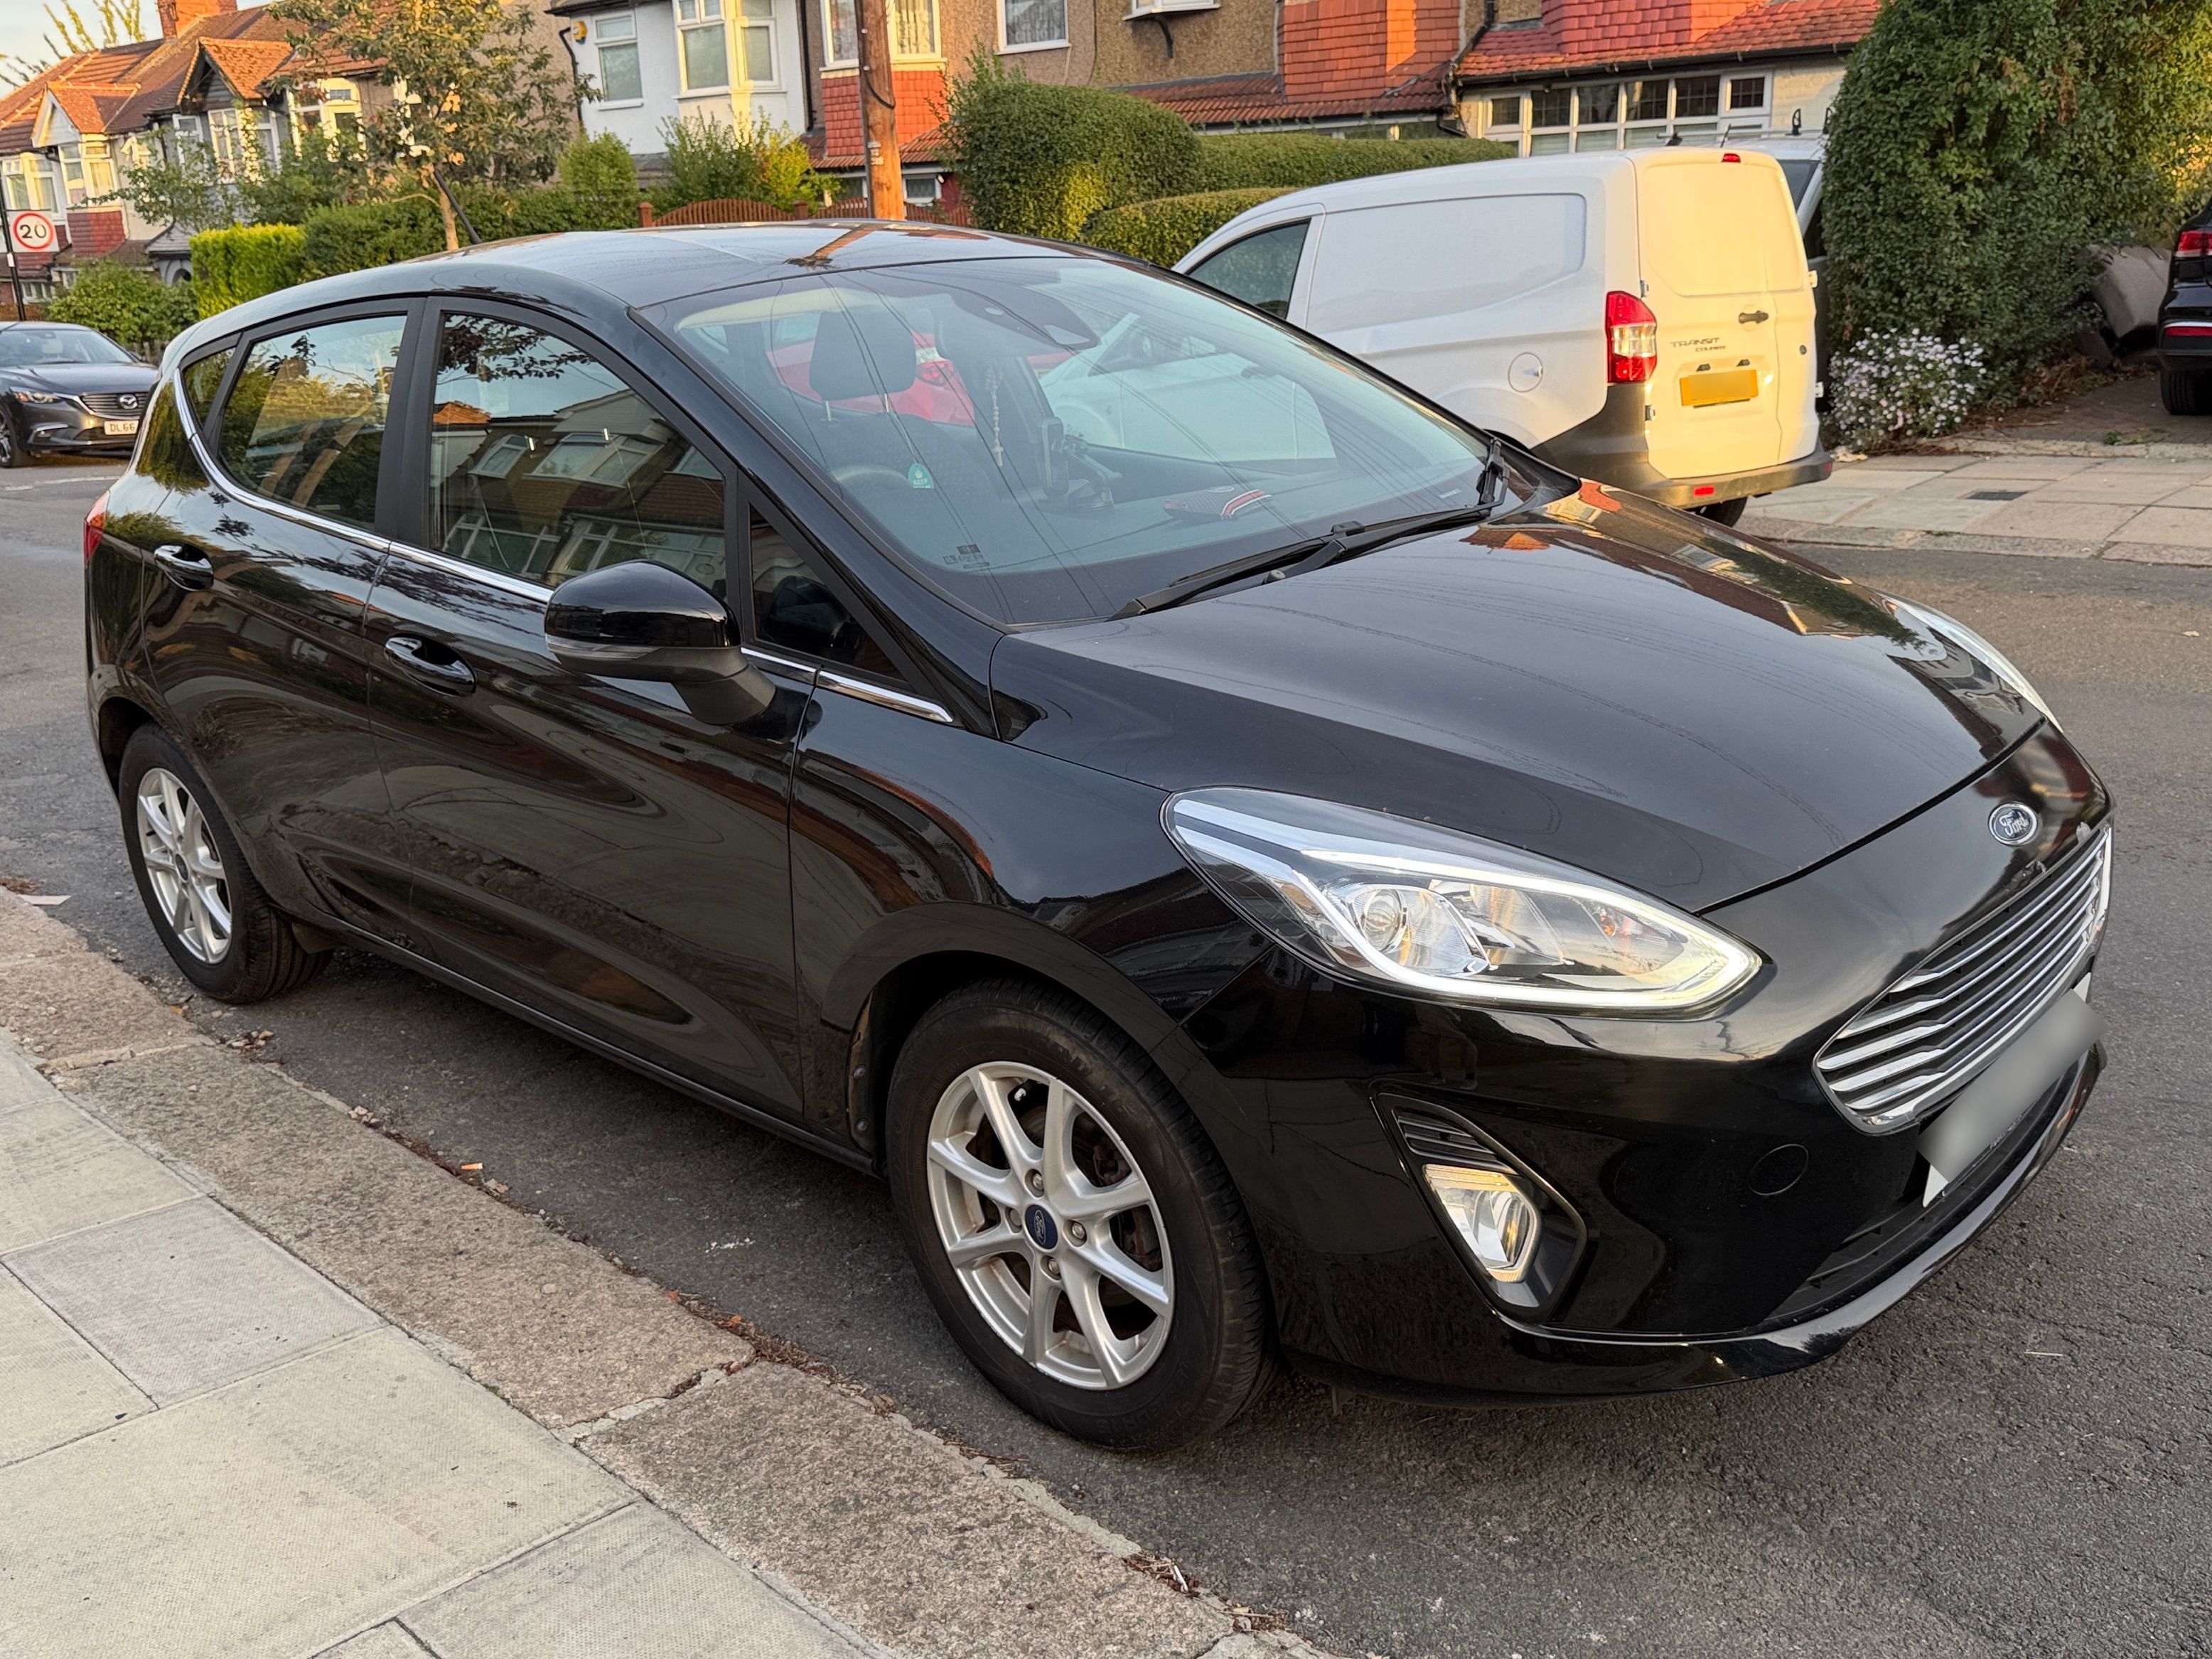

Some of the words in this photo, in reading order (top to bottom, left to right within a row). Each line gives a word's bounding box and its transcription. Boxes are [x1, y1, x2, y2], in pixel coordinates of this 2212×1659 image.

[20, 224, 47, 239] 20
[1670, 337, 1720, 348] TRANSIT
[110, 423, 135, 432] DL66
[1999, 810, 2030, 837] Ford
[1035, 1214, 1045, 1240] Ford
